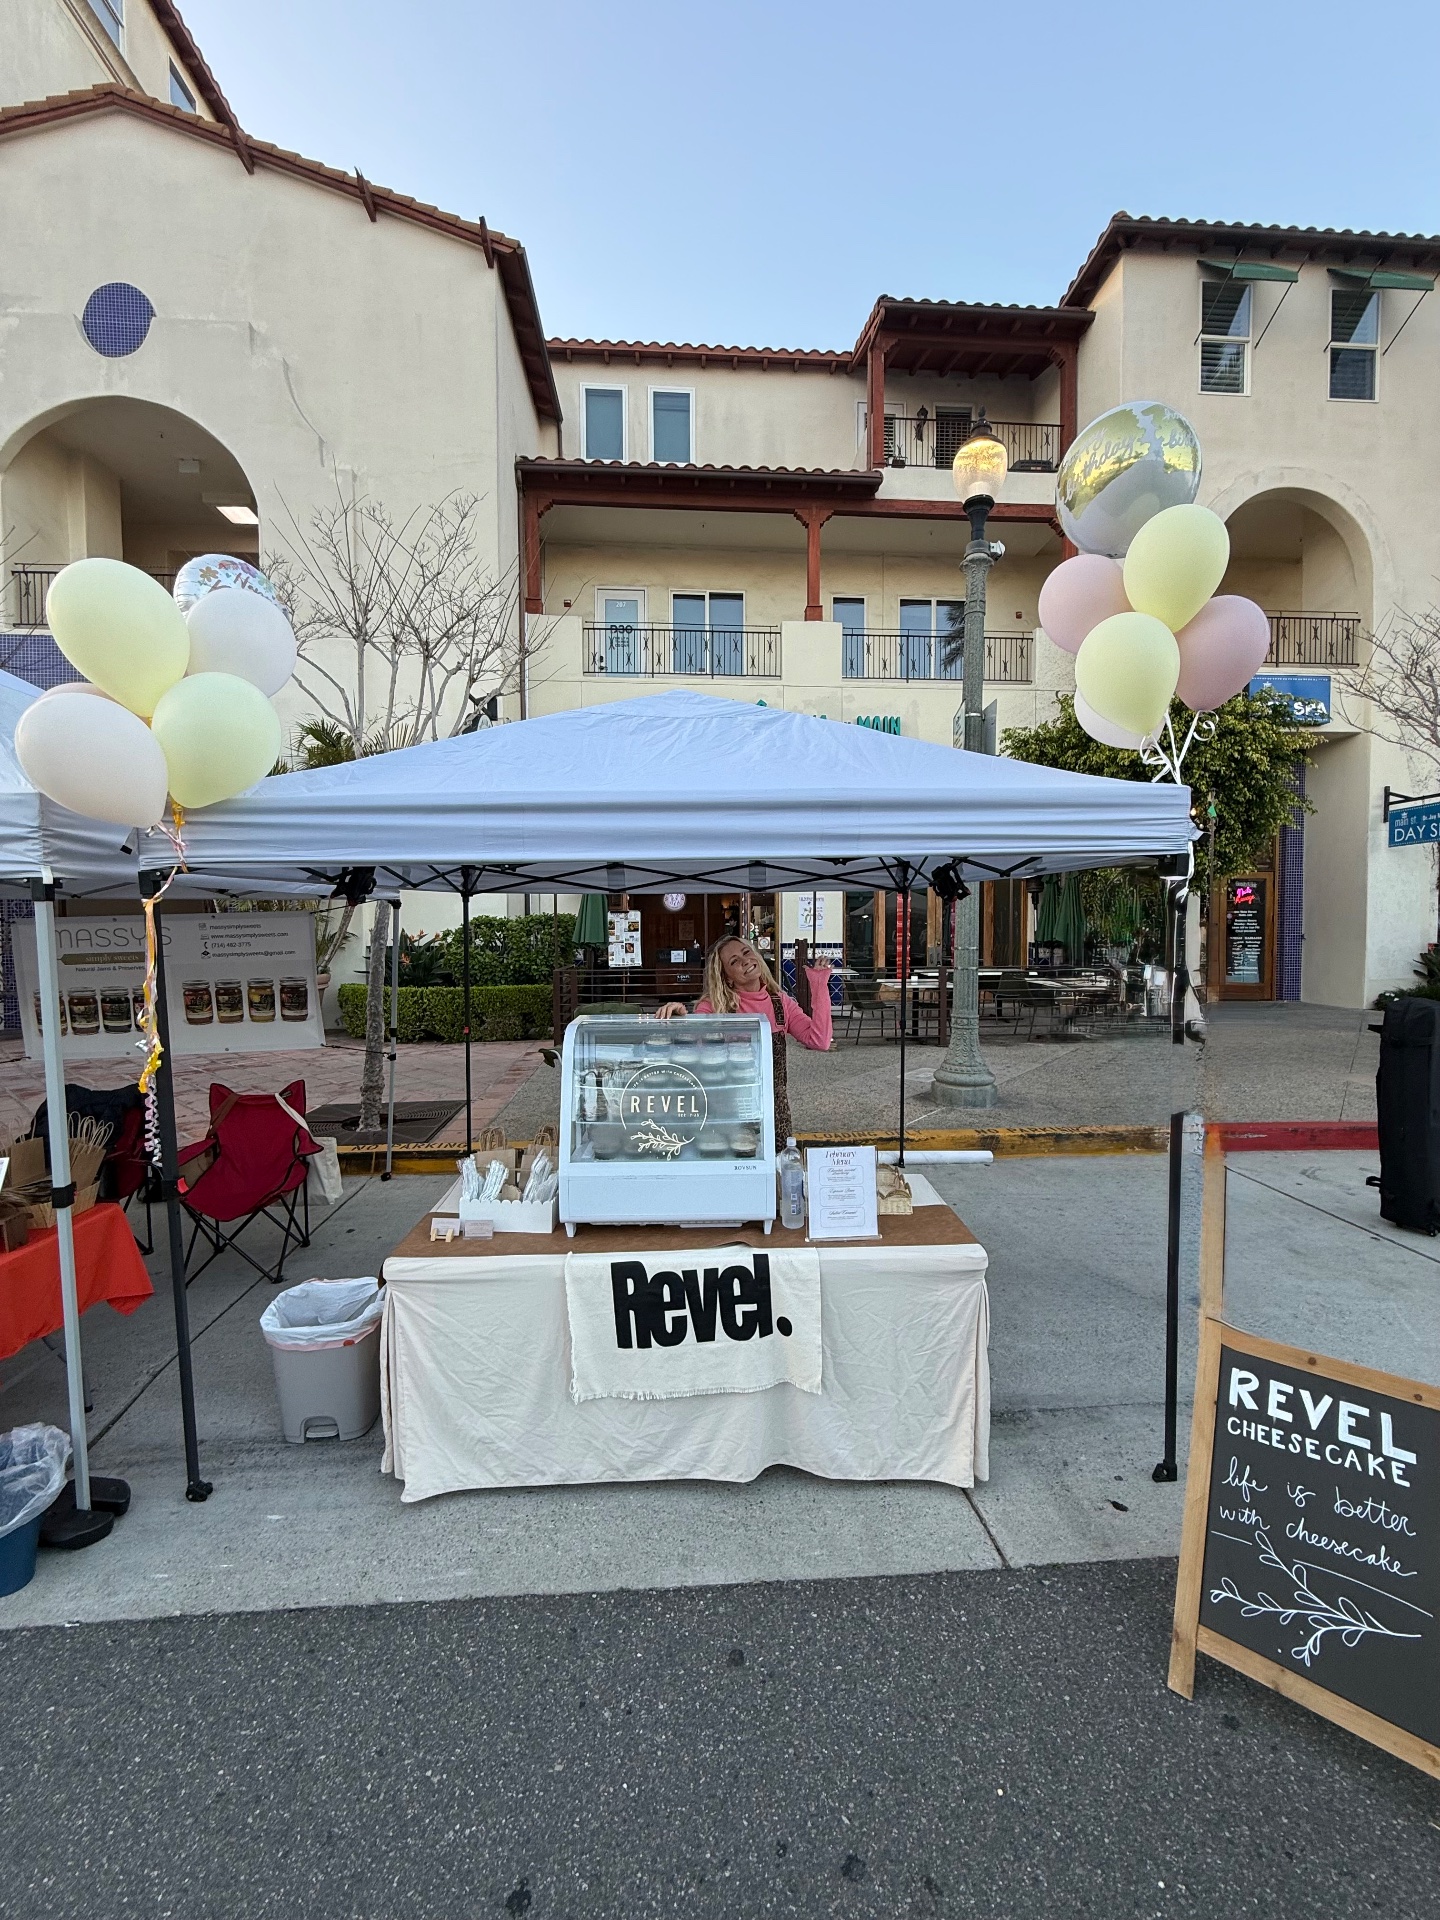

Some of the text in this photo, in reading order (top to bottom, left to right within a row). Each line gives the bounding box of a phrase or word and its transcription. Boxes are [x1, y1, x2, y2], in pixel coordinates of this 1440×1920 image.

[1394, 822, 1440, 842] DAY S
[85, 953, 111, 963] simply
[630, 1095, 699, 1113] REVEL
[813, 1130, 878, 1139] LOADING
[611, 1253, 793, 1349] Revel.
[1228, 1367, 1417, 1464] REVEL
[1227, 1416, 1411, 1488] CHEESECAKE
[1222, 1456, 1417, 1536] life is better
[1219, 1505, 1418, 1577] with cheesecake
